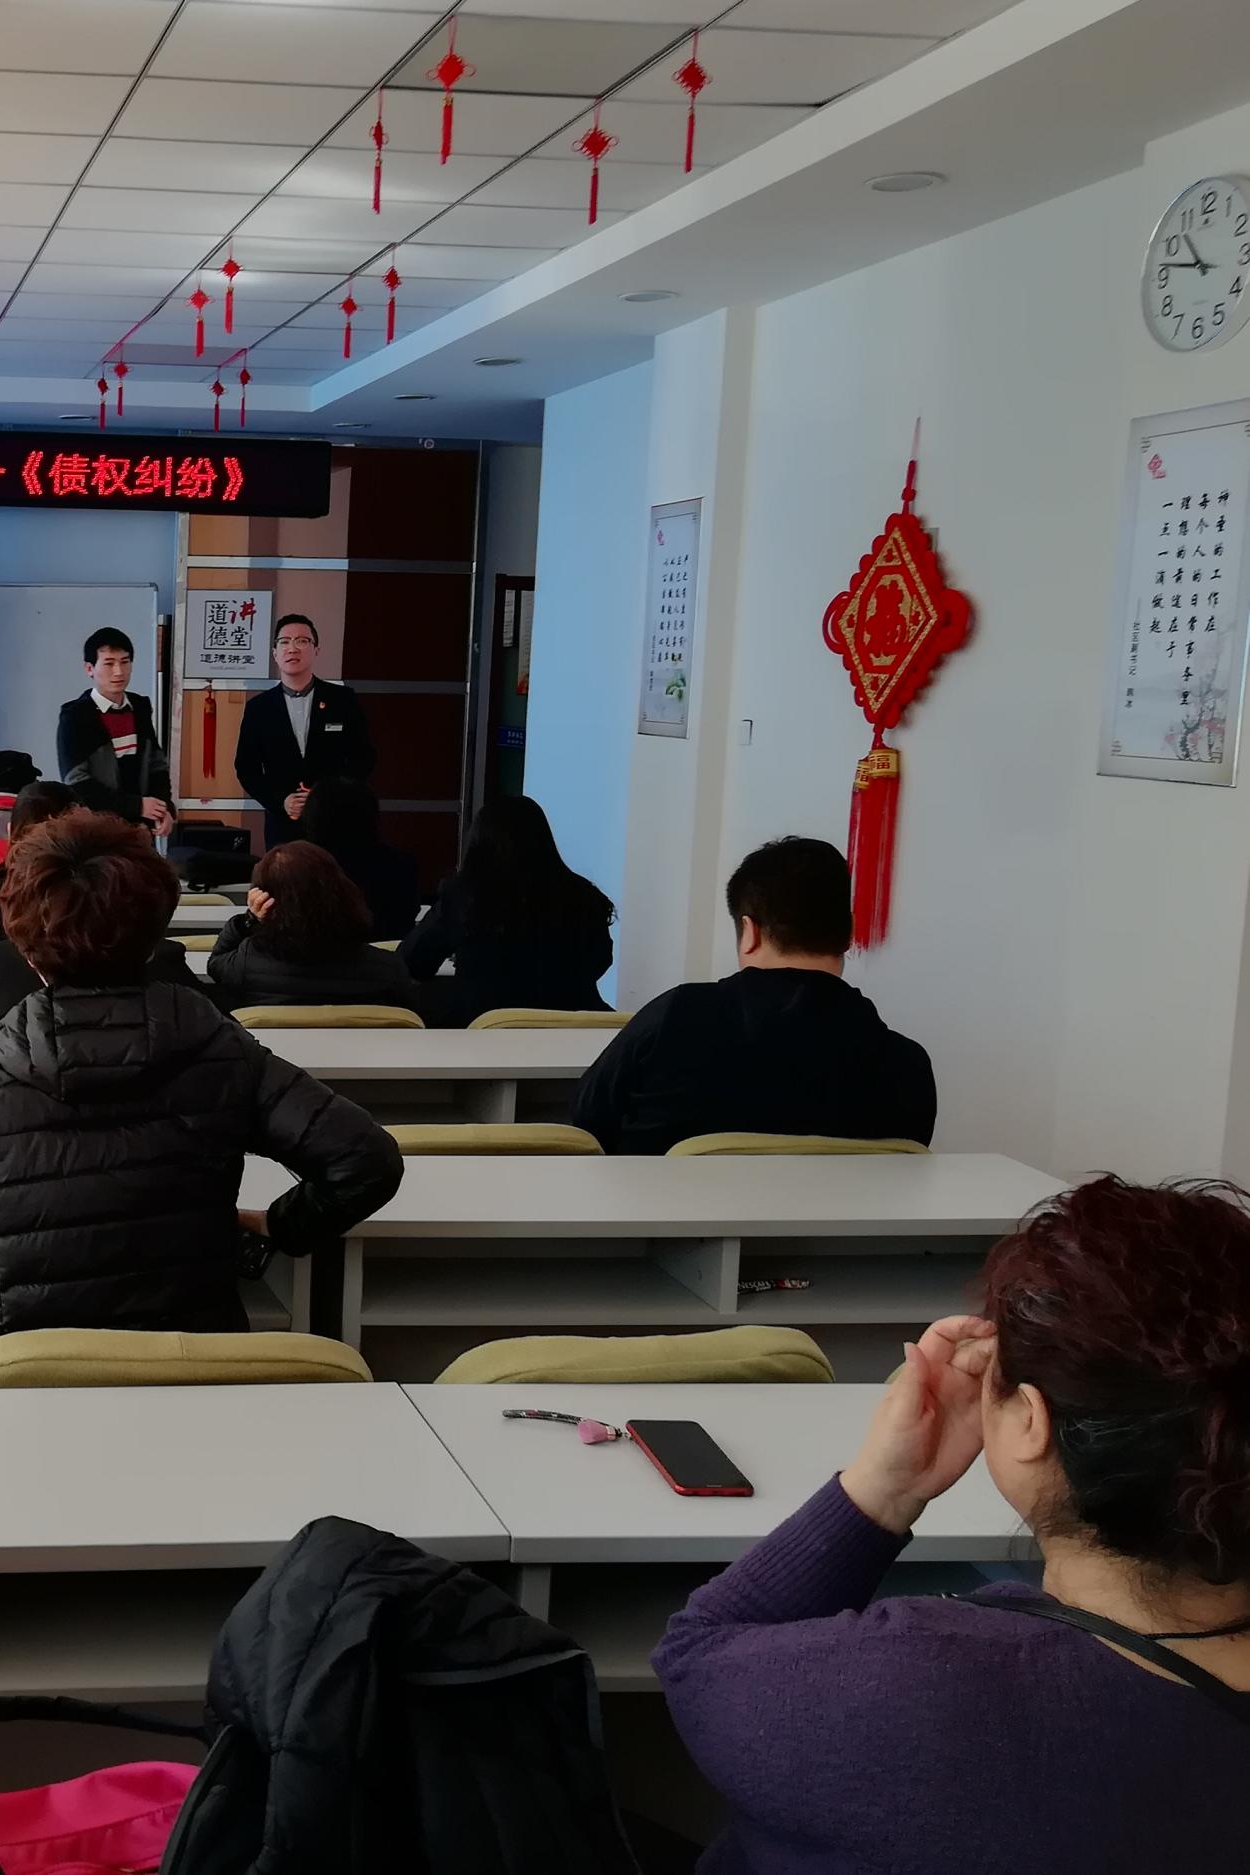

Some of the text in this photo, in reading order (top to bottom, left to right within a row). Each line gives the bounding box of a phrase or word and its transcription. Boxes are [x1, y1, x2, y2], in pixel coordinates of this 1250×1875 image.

[1200, 190, 1217, 216] 12
[1225, 194, 1232, 218] 1
[1181, 208, 1194, 232] 11
[1234, 213, 1248, 237] 2
[1165, 234, 1180, 257] 10
[1238, 242, 1250, 266] 3
[1157, 266, 1170, 289] 9
[1229, 275, 1242, 298] 4
[1160, 294, 1174, 317] 8
[1212, 302, 1226, 326] 5
[1172, 313, 1185, 339] 7
[1191, 317, 1204, 339] 6
